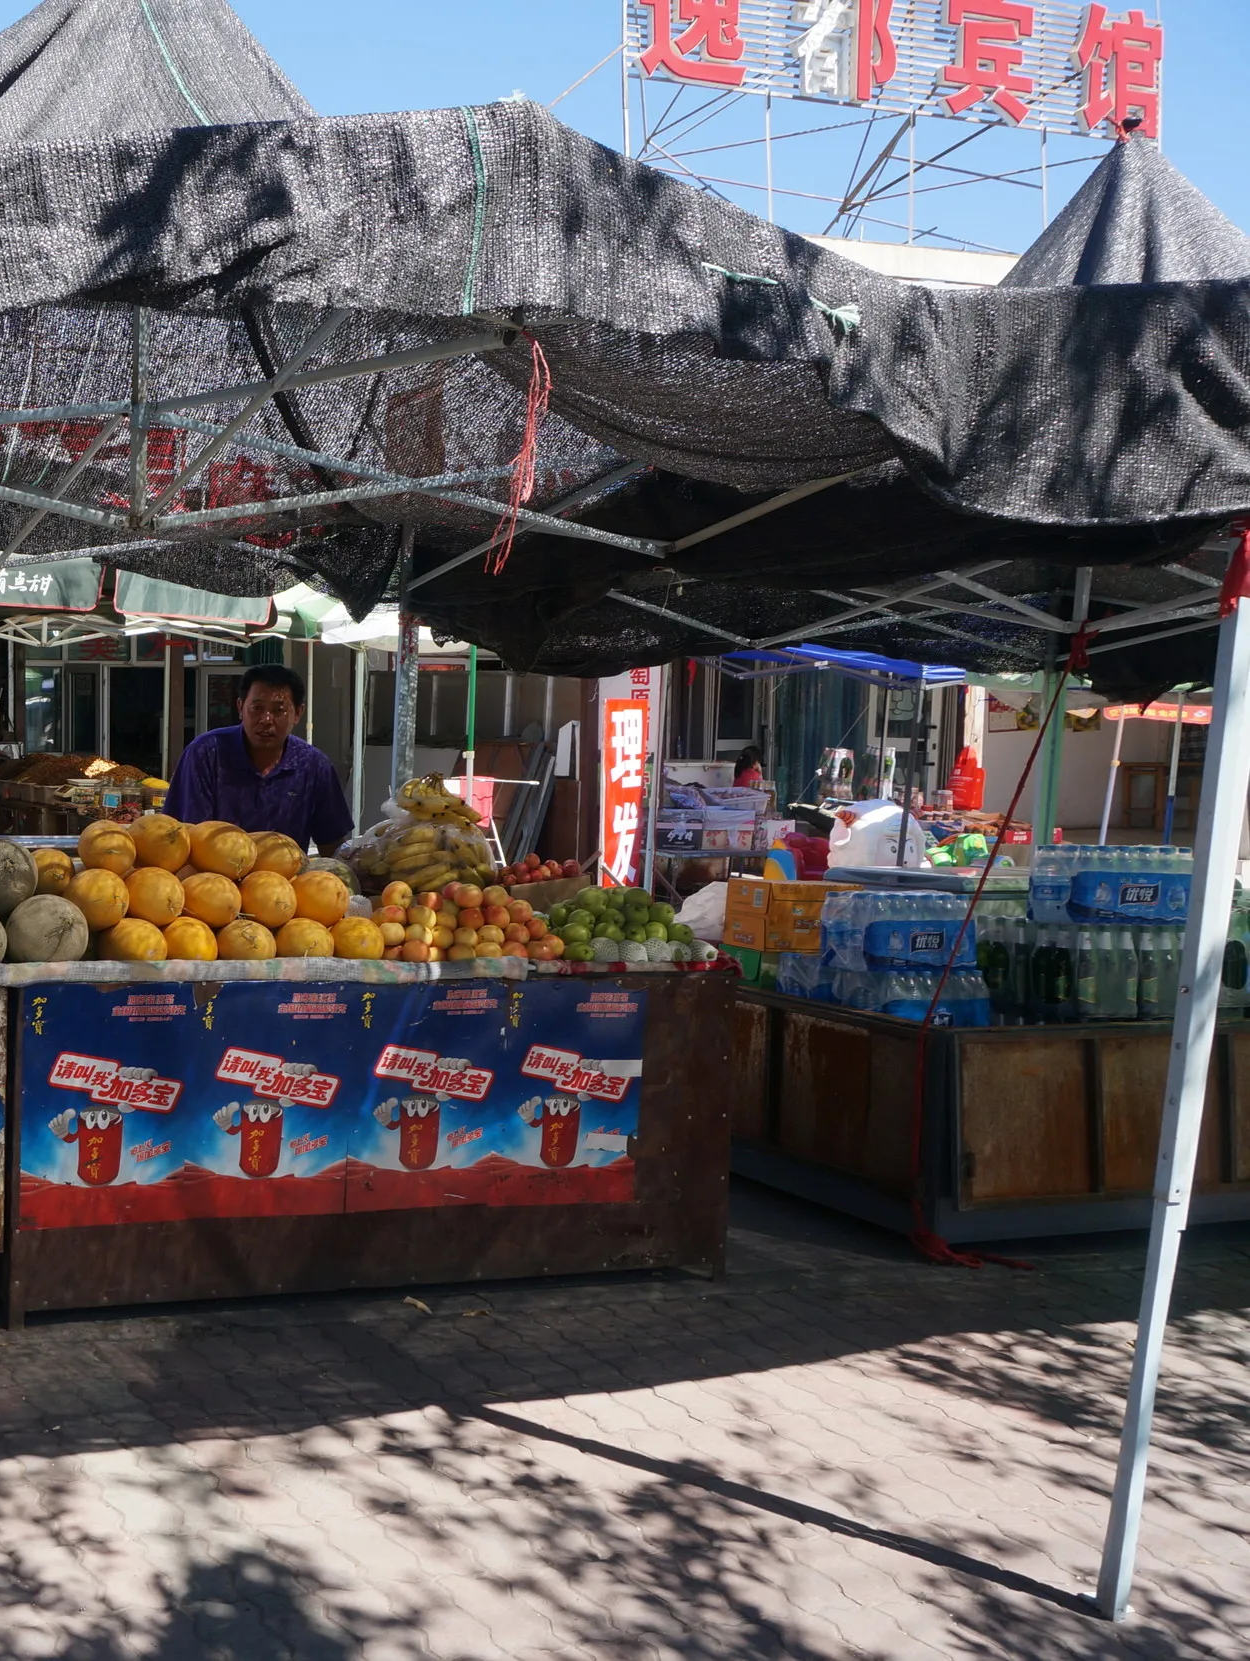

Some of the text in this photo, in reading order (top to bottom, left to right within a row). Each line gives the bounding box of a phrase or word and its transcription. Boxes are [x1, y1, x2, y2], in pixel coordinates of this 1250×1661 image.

[610, 709, 643, 886] 理发
[1125, 886, 1154, 903] 优悦
[915, 934, 940, 949] 优悦
[54, 1060, 175, 1105] 请叫我加多宝
[222, 1054, 333, 1101] 请叫我加多宝
[381, 1052, 488, 1096] 请叫我加多宝
